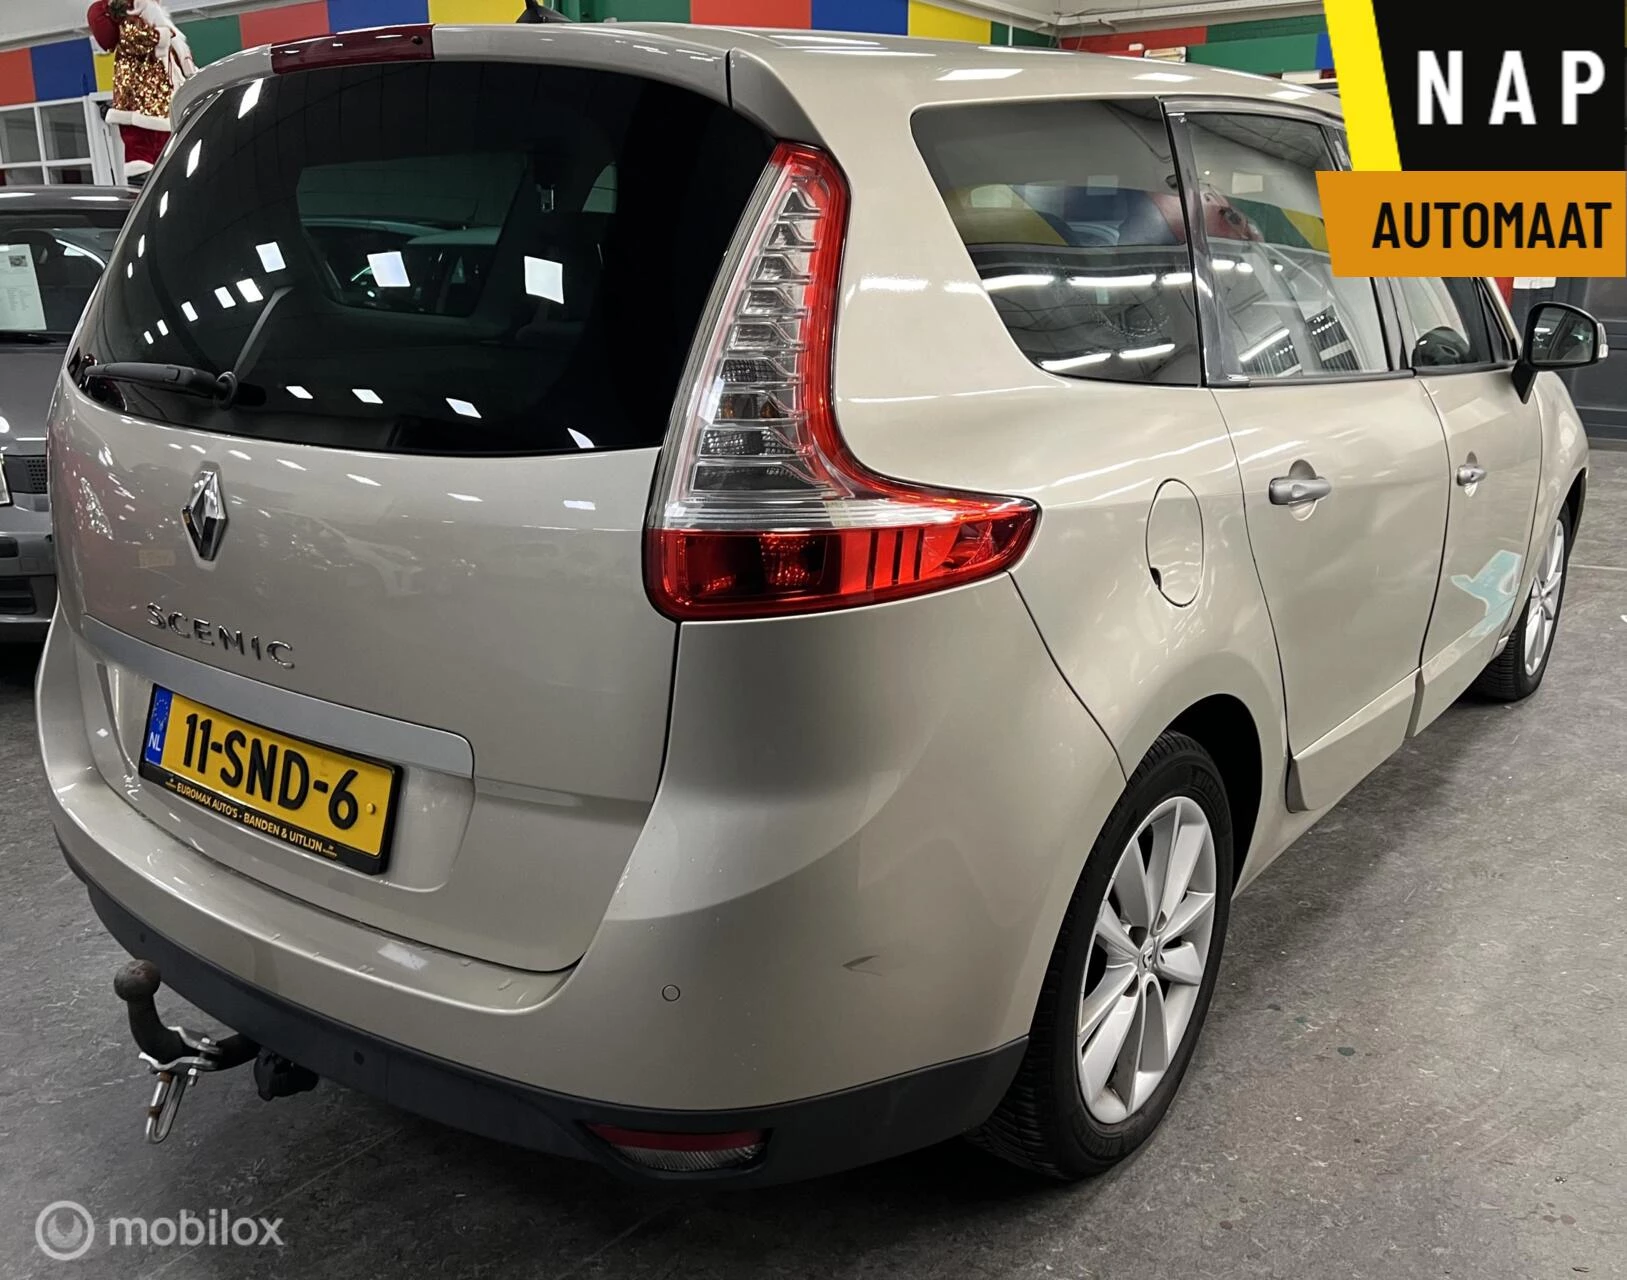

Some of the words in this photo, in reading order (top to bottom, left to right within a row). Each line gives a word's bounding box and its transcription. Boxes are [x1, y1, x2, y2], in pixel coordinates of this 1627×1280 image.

[146, 602, 295, 669] SCENIC
[148, 731, 161, 752] NL
[182, 712, 360, 831] 11-SND-6
[176, 782, 212, 806] EUROMAX
[211, 800, 238, 818] AUTO'S
[243, 813, 280, 836] BANDEN
[280, 827, 288, 839] &
[289, 832, 323, 853] UITLIJN
